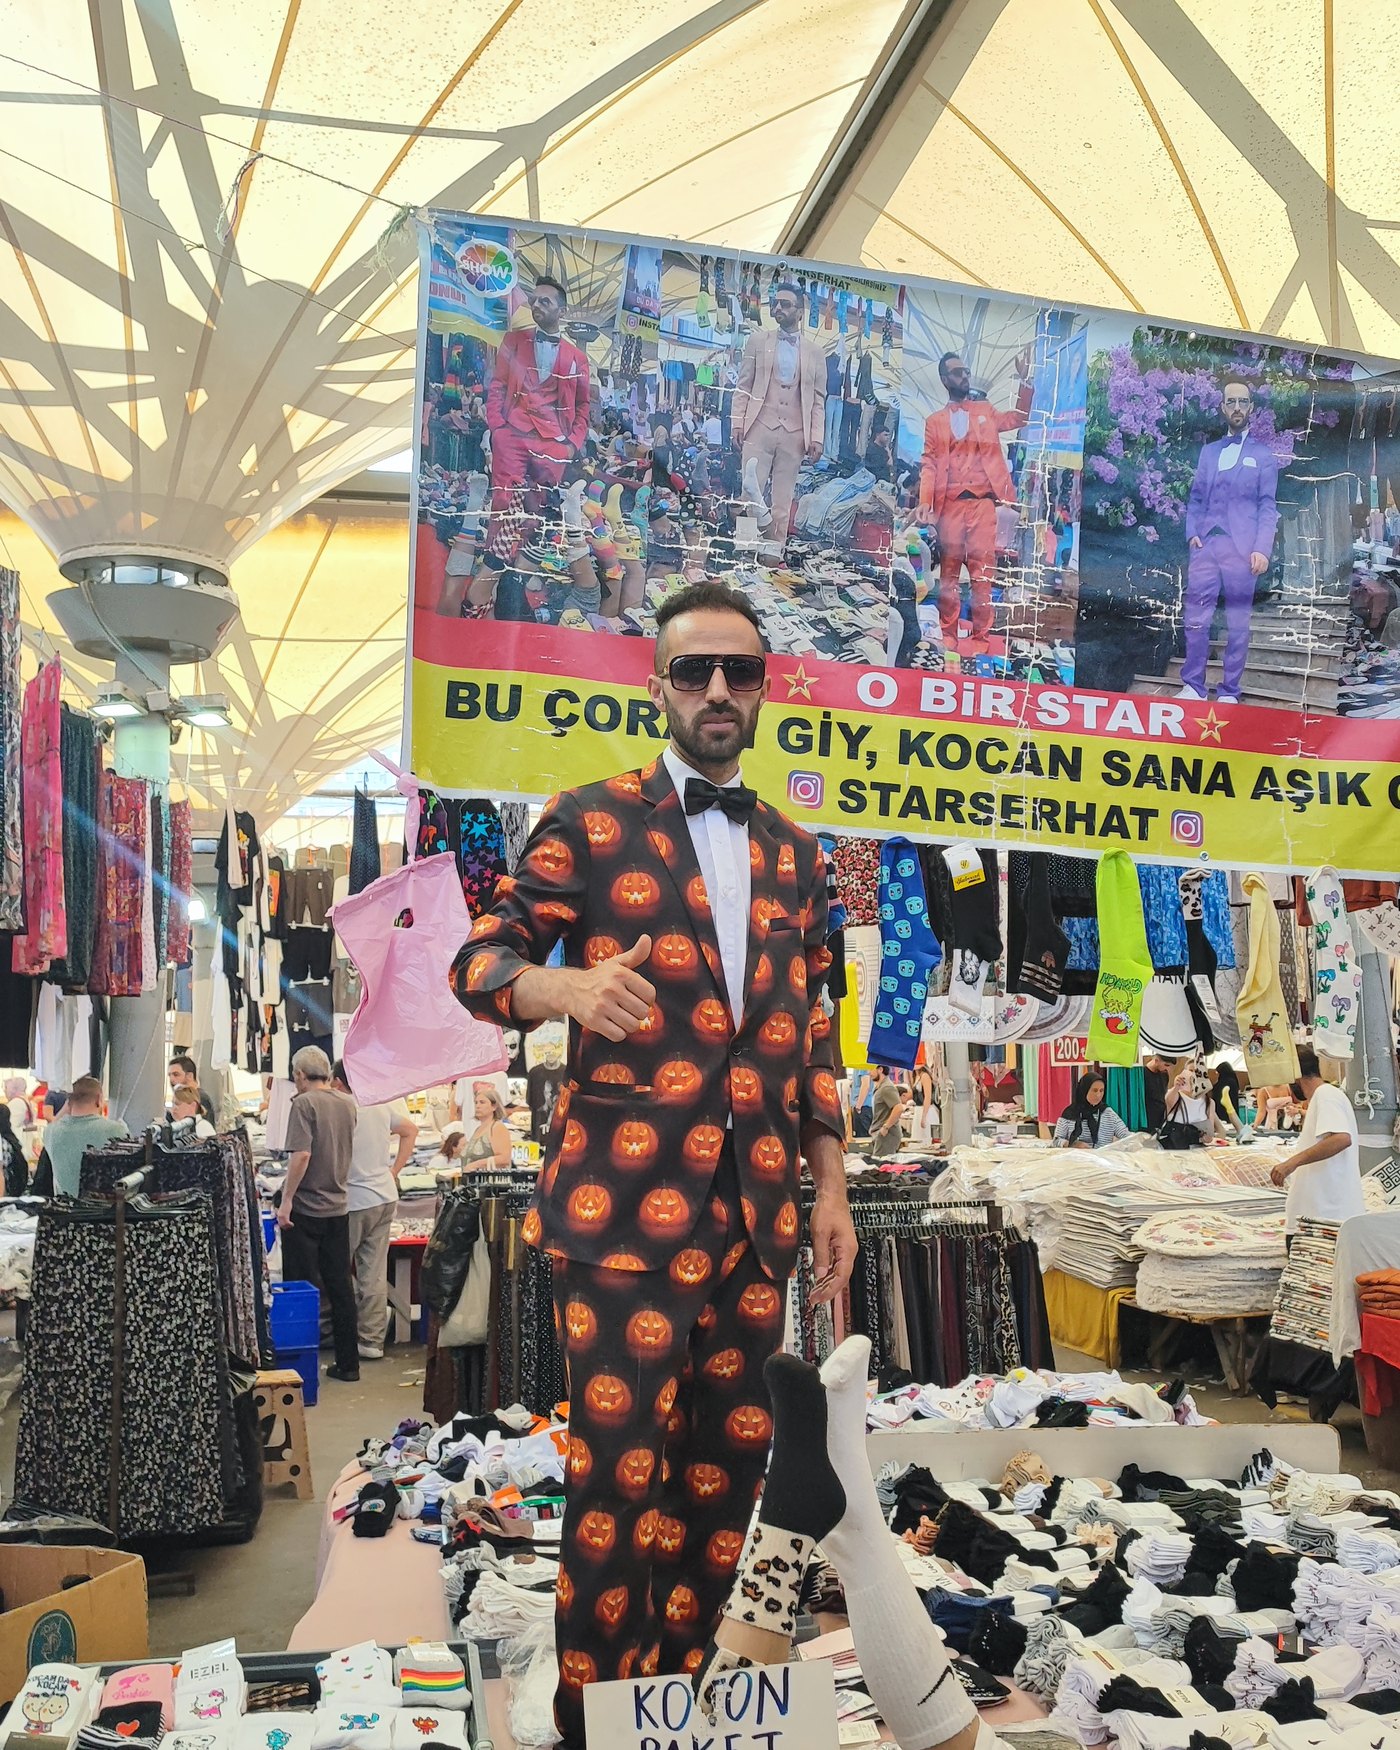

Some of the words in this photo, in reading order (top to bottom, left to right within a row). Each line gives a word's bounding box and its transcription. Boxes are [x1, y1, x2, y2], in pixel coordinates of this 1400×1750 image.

[856, 671, 899, 708] O
[1036, 691, 1187, 738] STAR
[445, 680, 522, 722] BU
[898, 729, 1082, 783] KOCAN
[1101, 750, 1236, 798] SANA
[1250, 766, 1372, 812] AŞIK
[838, 778, 1159, 841] STARSERHAT
[1057, 1037, 1080, 1060] 200
[634, 1667, 790, 1731] KOON
